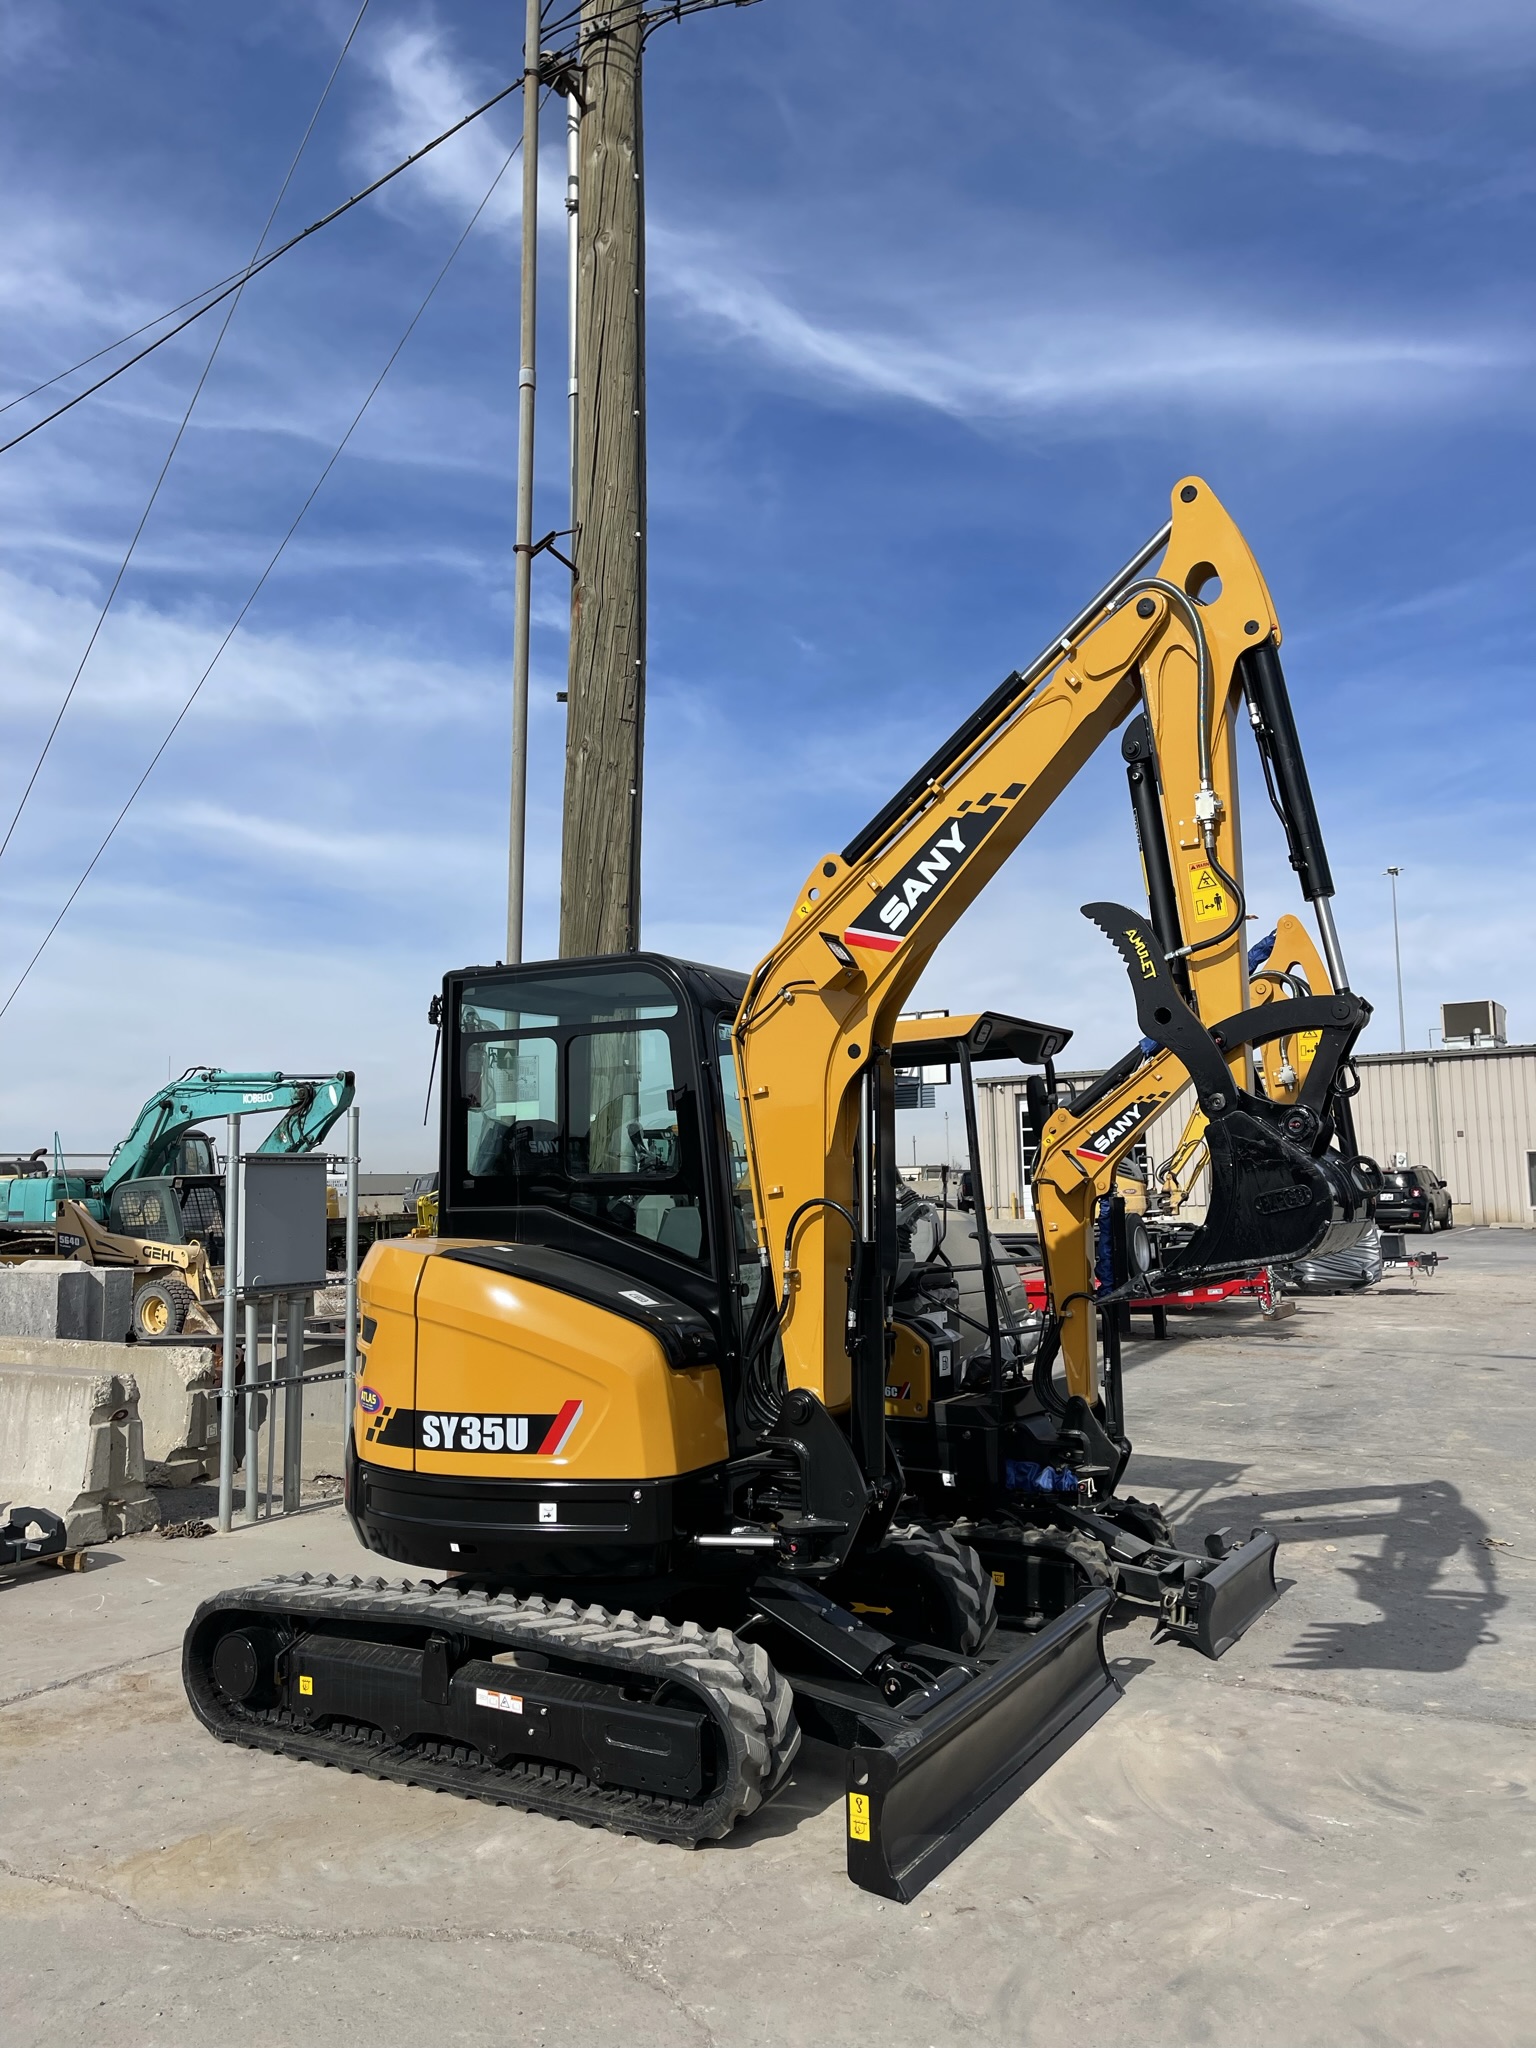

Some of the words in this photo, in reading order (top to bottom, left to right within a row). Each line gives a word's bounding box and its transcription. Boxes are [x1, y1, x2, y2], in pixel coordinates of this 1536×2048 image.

[879, 820, 967, 932] SANY
[1124, 929, 1157, 979] AMULET
[1094, 1104, 1141, 1152] SANY
[528, 1140, 559, 1153] SANY
[59, 1235, 80, 1246] 5640
[142, 1245, 179, 1264] GEHL
[360, 1390, 377, 1405] ATLAS
[885, 1386, 898, 1397] 6C
[422, 1415, 529, 1451] SY35U
